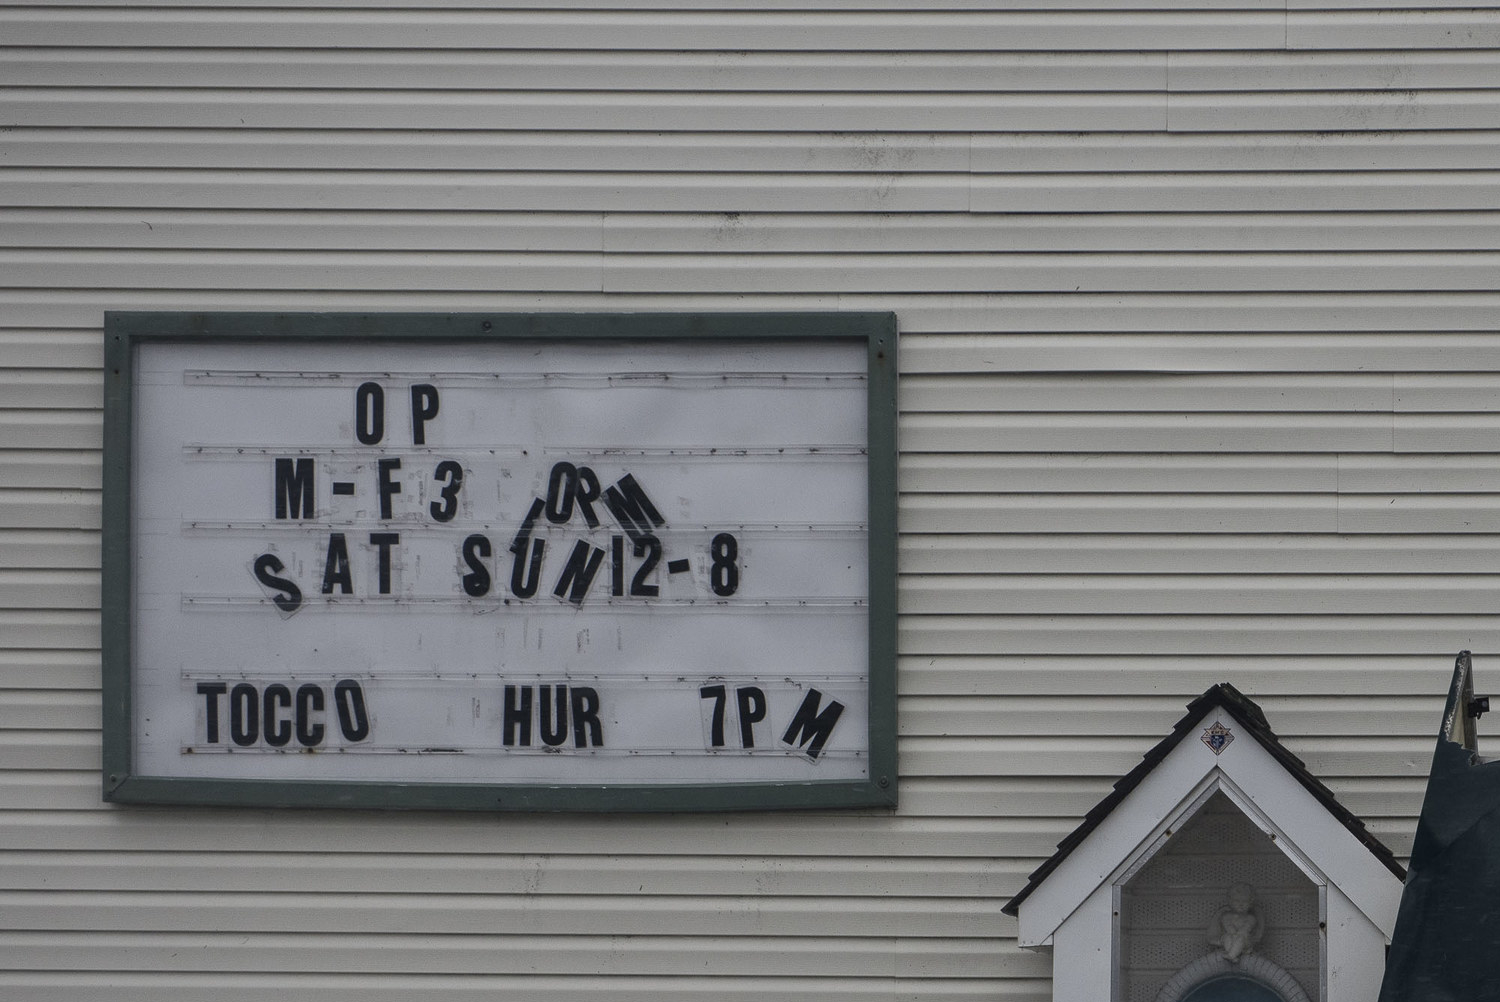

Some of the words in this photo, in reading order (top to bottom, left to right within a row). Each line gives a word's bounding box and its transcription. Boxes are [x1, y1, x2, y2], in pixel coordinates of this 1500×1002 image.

[253, 532, 400, 612] SAT
[462, 533, 605, 606] SUN
[196, 678, 369, 747] TOCCO
[502, 683, 604, 749] HUR
